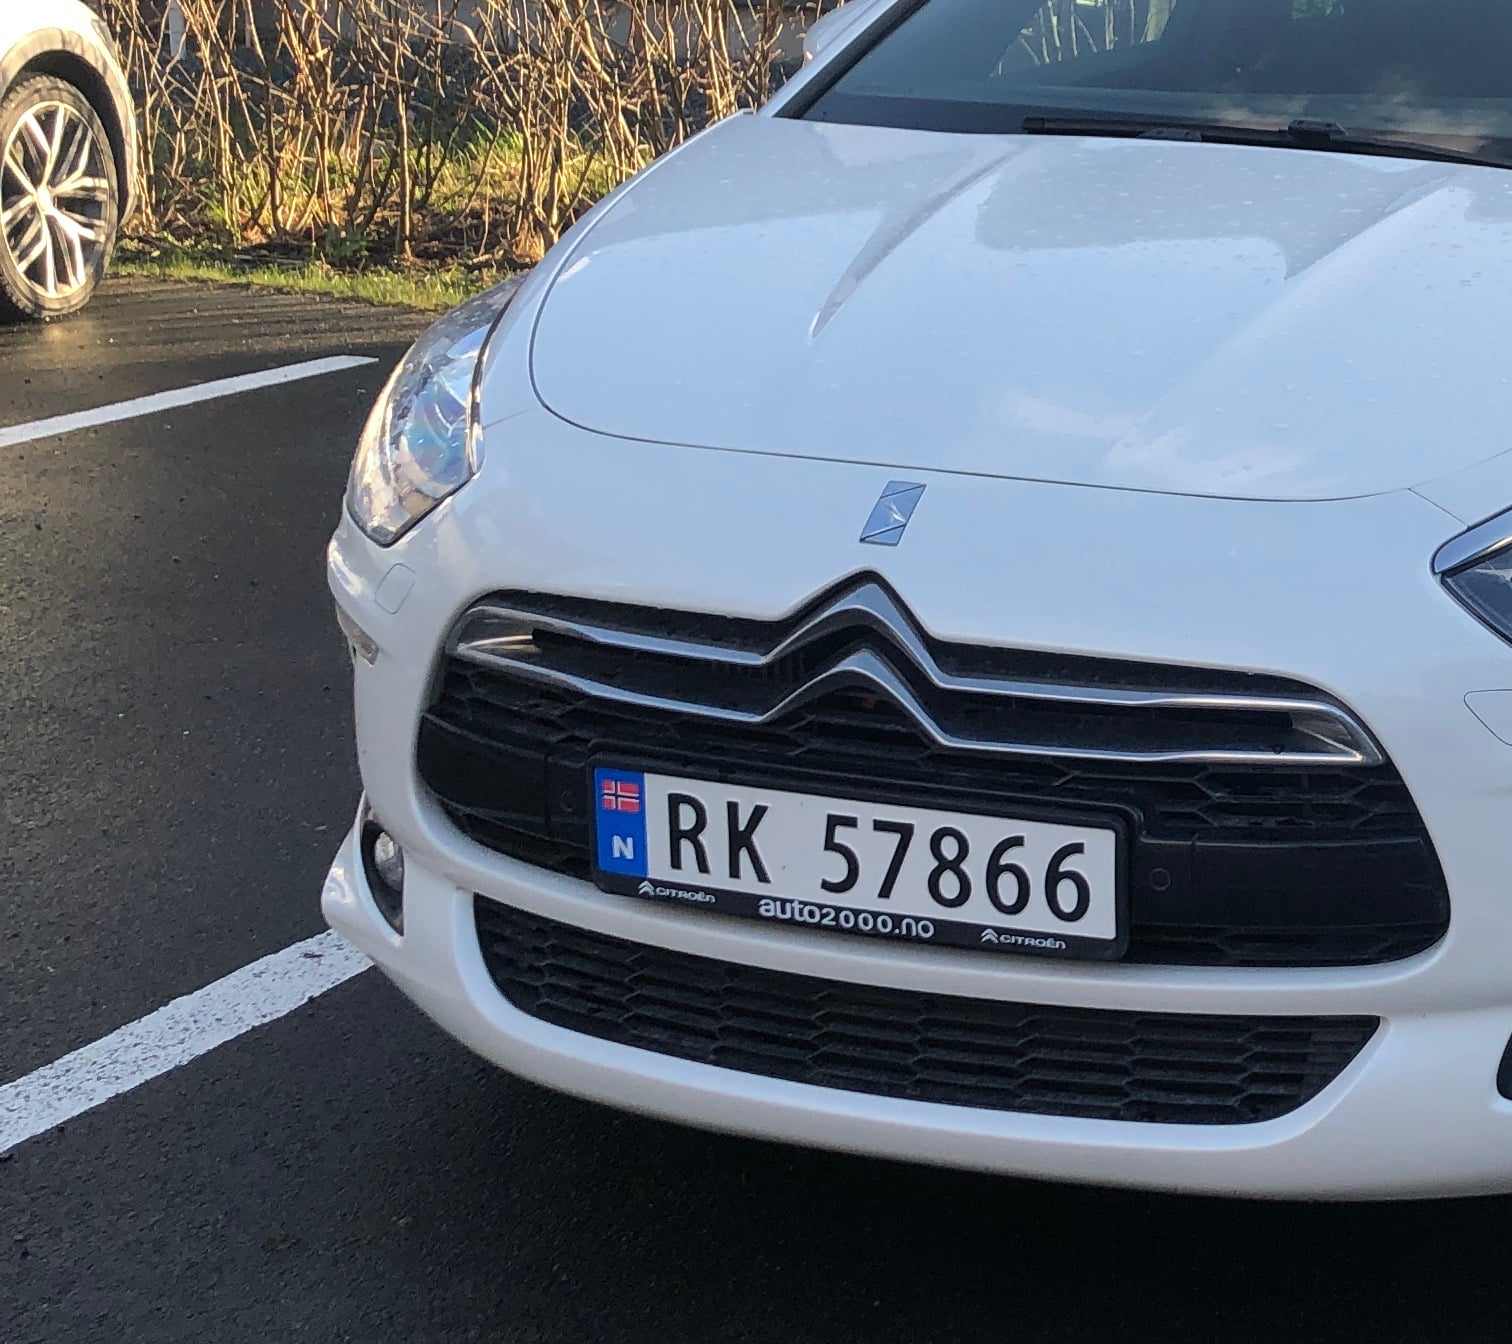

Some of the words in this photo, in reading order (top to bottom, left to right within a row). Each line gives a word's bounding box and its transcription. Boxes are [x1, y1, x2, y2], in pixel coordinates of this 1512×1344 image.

[612, 835, 635, 859] N
[667, 792, 772, 884] RK
[820, 812, 1092, 923] 57866
[758, 898, 935, 938] auto2000.no
